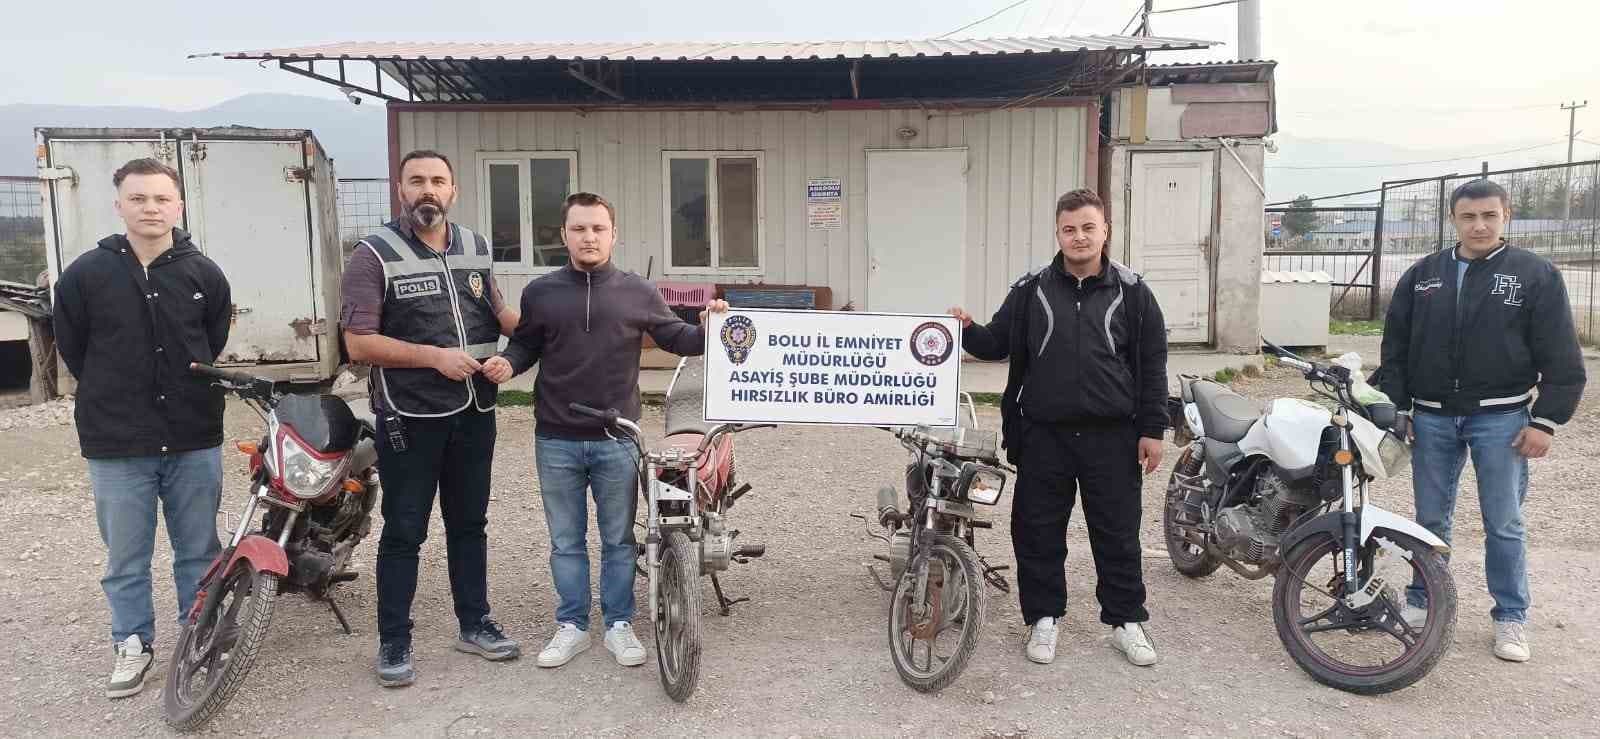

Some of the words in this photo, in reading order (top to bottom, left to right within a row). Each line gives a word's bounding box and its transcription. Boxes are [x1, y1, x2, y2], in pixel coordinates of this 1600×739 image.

[768, 334, 811, 348] BOLU
[817, 332, 830, 348] İL
[835, 334, 903, 350] EMNİYET
[782, 350, 887, 368] MÜDÜRLÜĞÜ
[729, 368, 784, 388] ASAYİŞ
[789, 371, 829, 388] ŞUBE
[833, 370, 937, 388] MÜDÜRLÜĞÜ
[731, 388, 809, 403] HIRSIZLIK
[813, 387, 858, 405] BÜRO
[863, 389, 935, 406] AMİRLİĞİ
[1345, 548, 1354, 582] facebook
